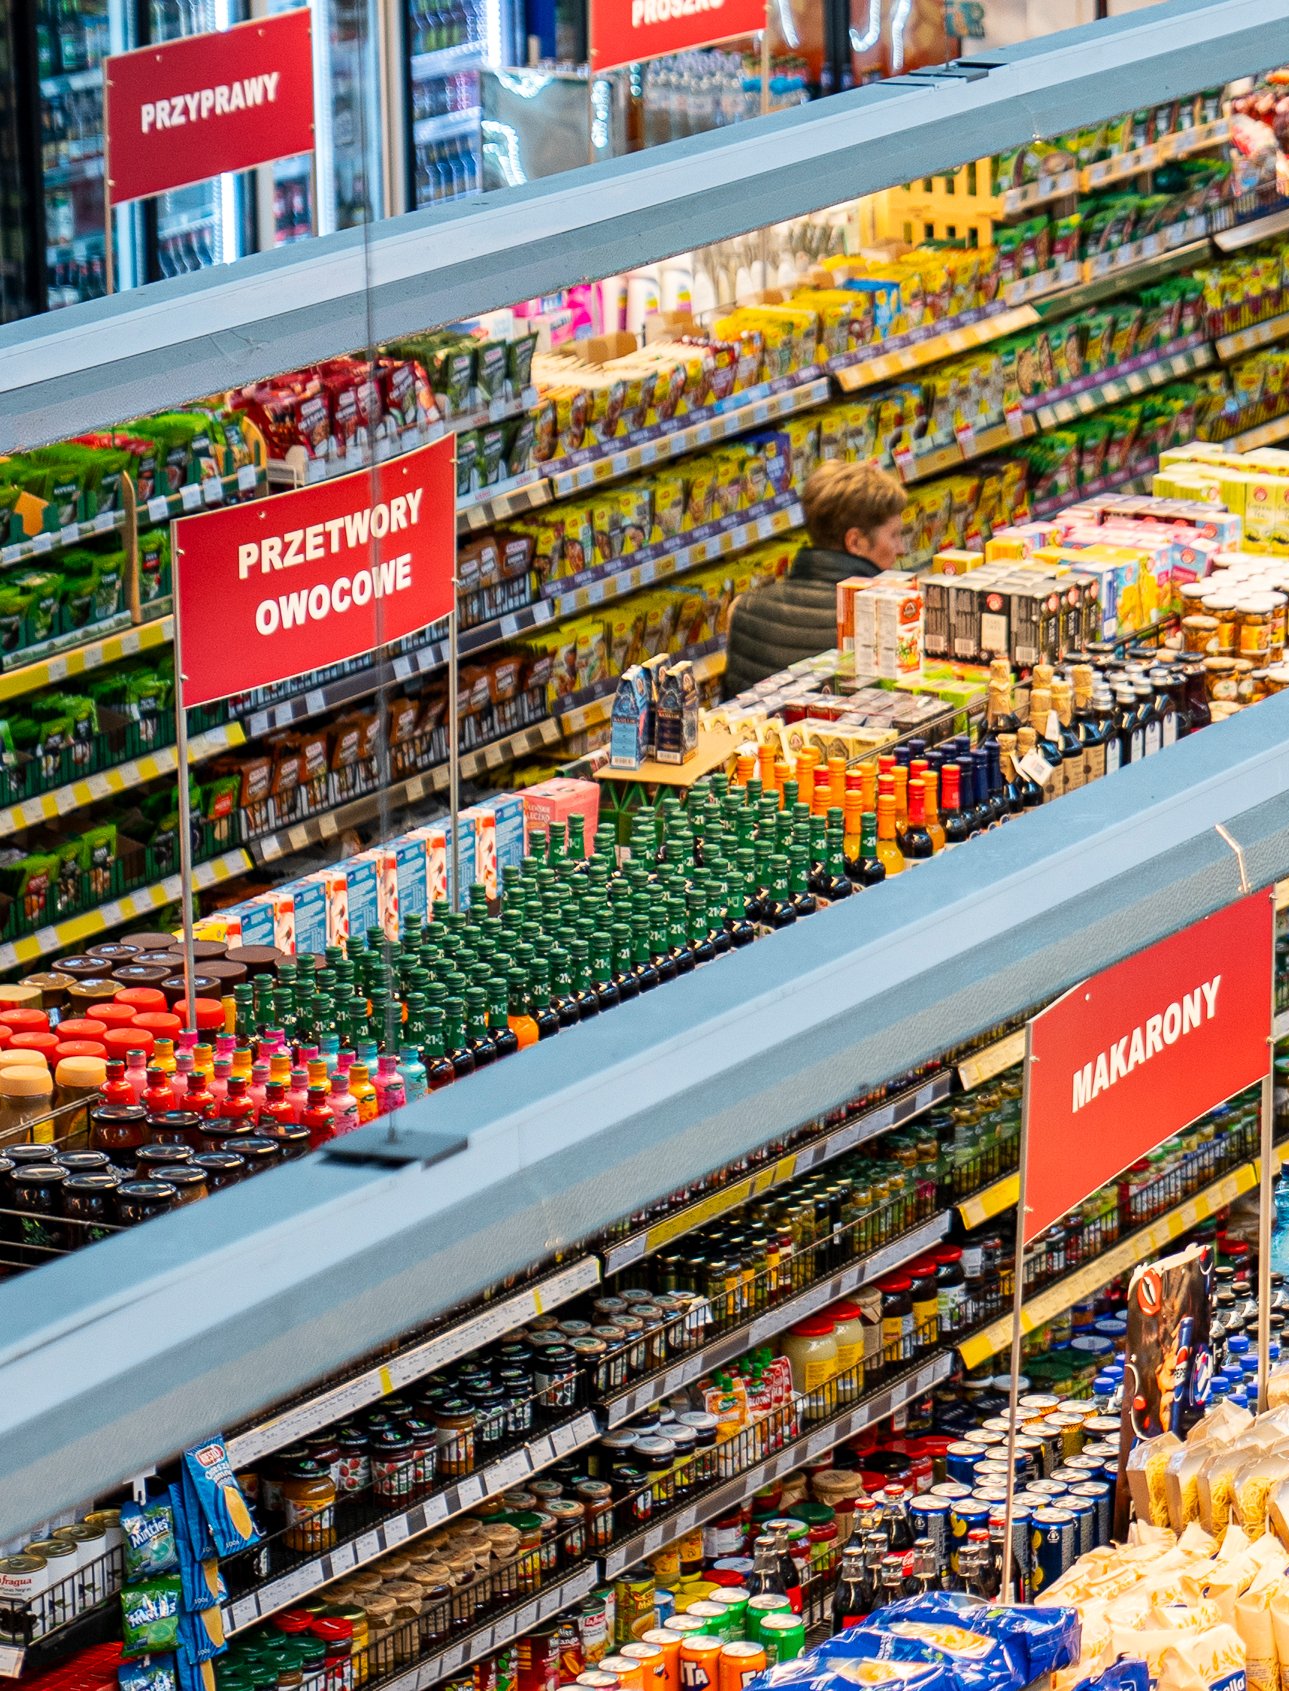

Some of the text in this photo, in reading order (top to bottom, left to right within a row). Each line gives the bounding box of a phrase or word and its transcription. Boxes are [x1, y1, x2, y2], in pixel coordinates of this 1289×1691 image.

[631, 0, 725, 28] PROSZ
[141, 71, 279, 133] PRZYPRAWY
[238, 488, 423, 579] PRZETWORY
[255, 553, 412, 635] OWOCOWE
[1072, 975, 1221, 1113] MAKARONY
